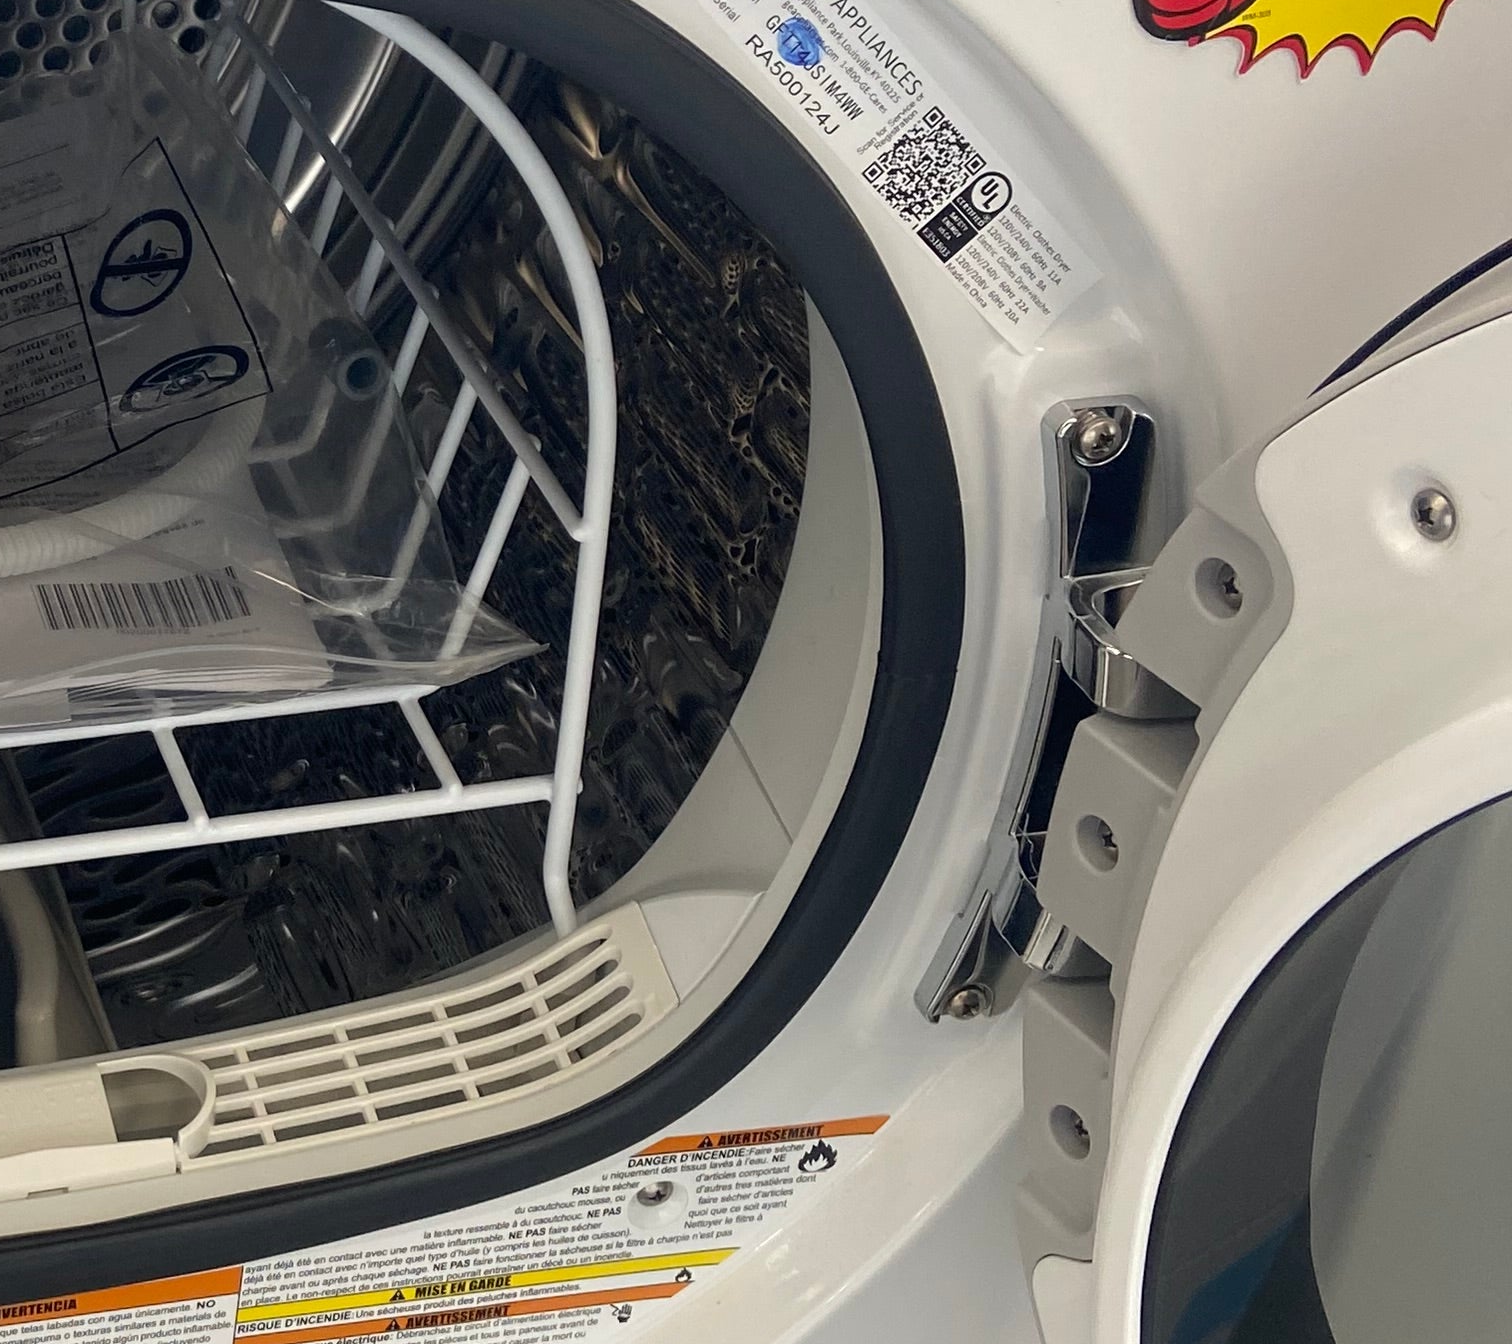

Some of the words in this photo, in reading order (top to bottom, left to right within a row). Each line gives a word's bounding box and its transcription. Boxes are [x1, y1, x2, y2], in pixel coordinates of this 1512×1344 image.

[743, 33, 841, 136] RA500124J
[717, 1124, 824, 1147] AVERTISSEMENT
[628, 1154, 677, 1168] DANGER
[415, 1283, 447, 1298] MISE
[450, 1281, 464, 1294] EN
[467, 1274, 511, 1292] GARDE
[238, 1319, 281, 1334] RISQUE
[406, 1304, 510, 1330] AVERTISSEMENT
